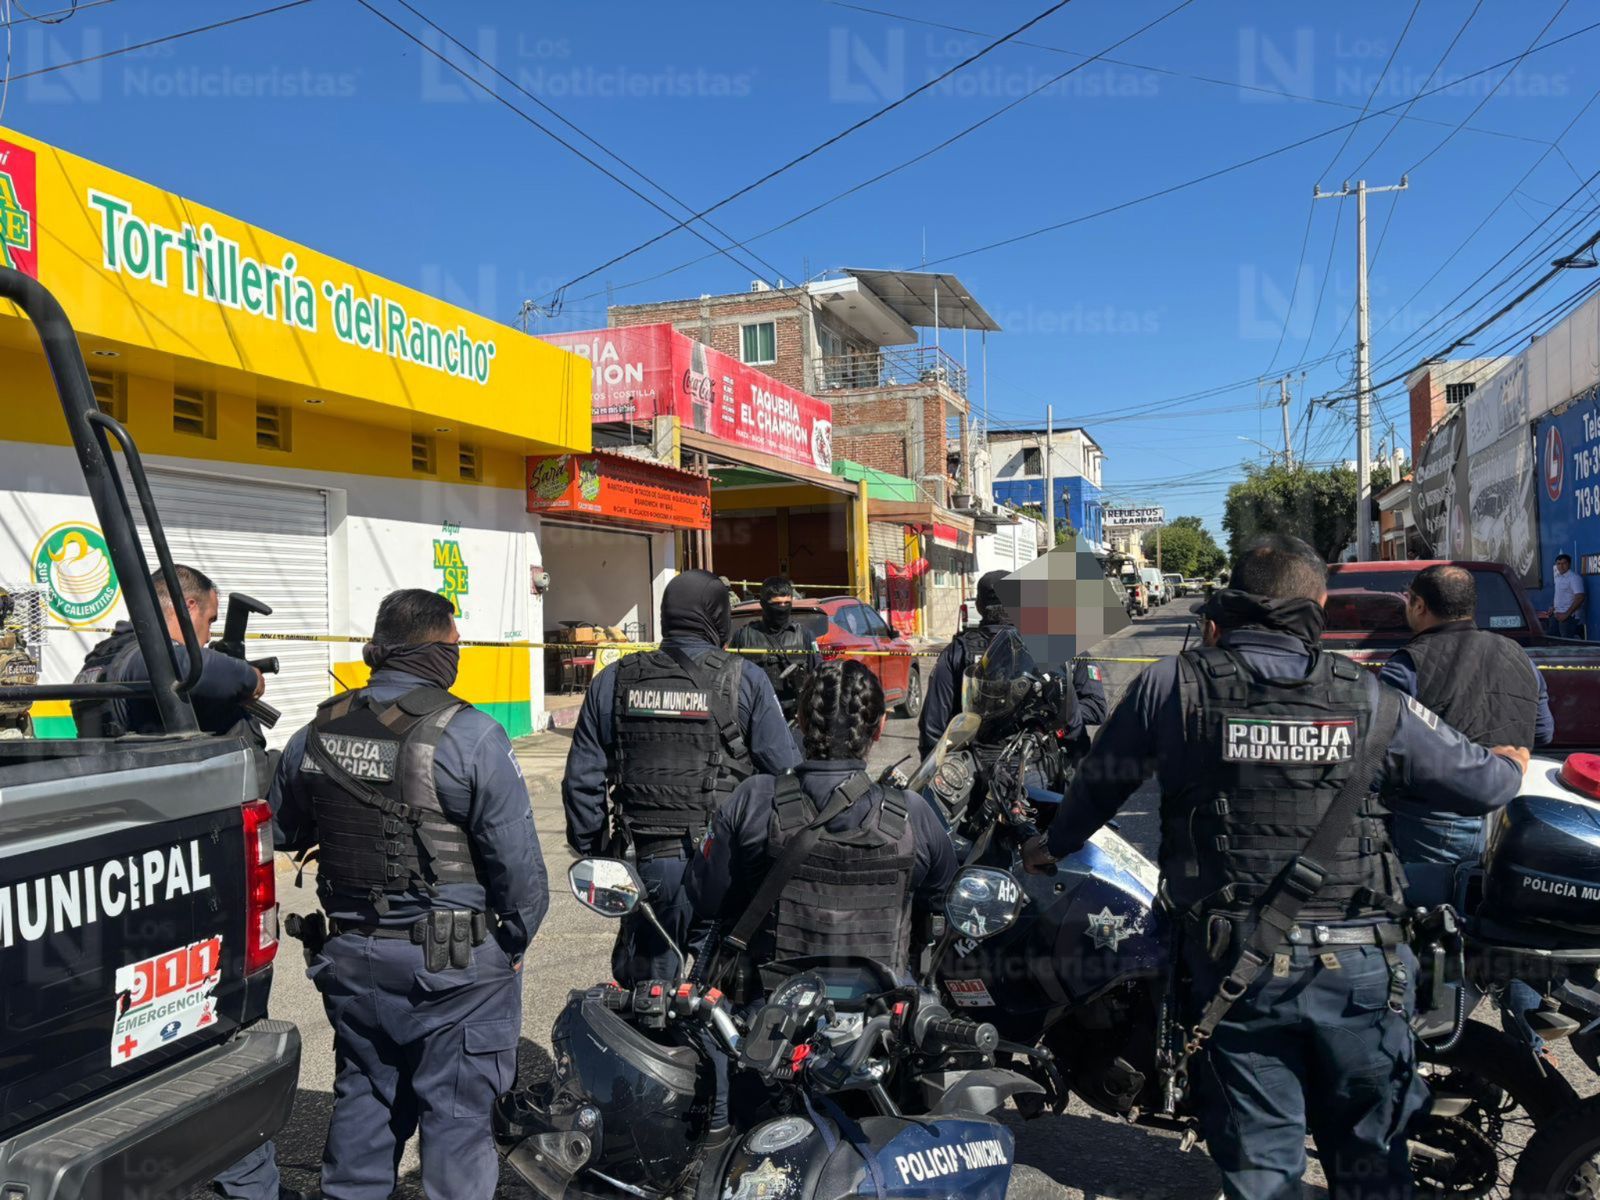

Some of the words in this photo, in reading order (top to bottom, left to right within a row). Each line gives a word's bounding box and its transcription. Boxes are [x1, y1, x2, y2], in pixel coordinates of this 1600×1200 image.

[592, 362, 643, 386] ION
[613, 389, 656, 399] COSTILLA
[741, 402, 755, 427] EL
[757, 409, 808, 446] CHAMPION
[1108, 507, 1159, 518] REPUESTOS
[662, 691, 709, 712] MUNICIPAL
[1227, 745, 1352, 762] MUNICIPAL
[130, 945, 213, 1002] 911
